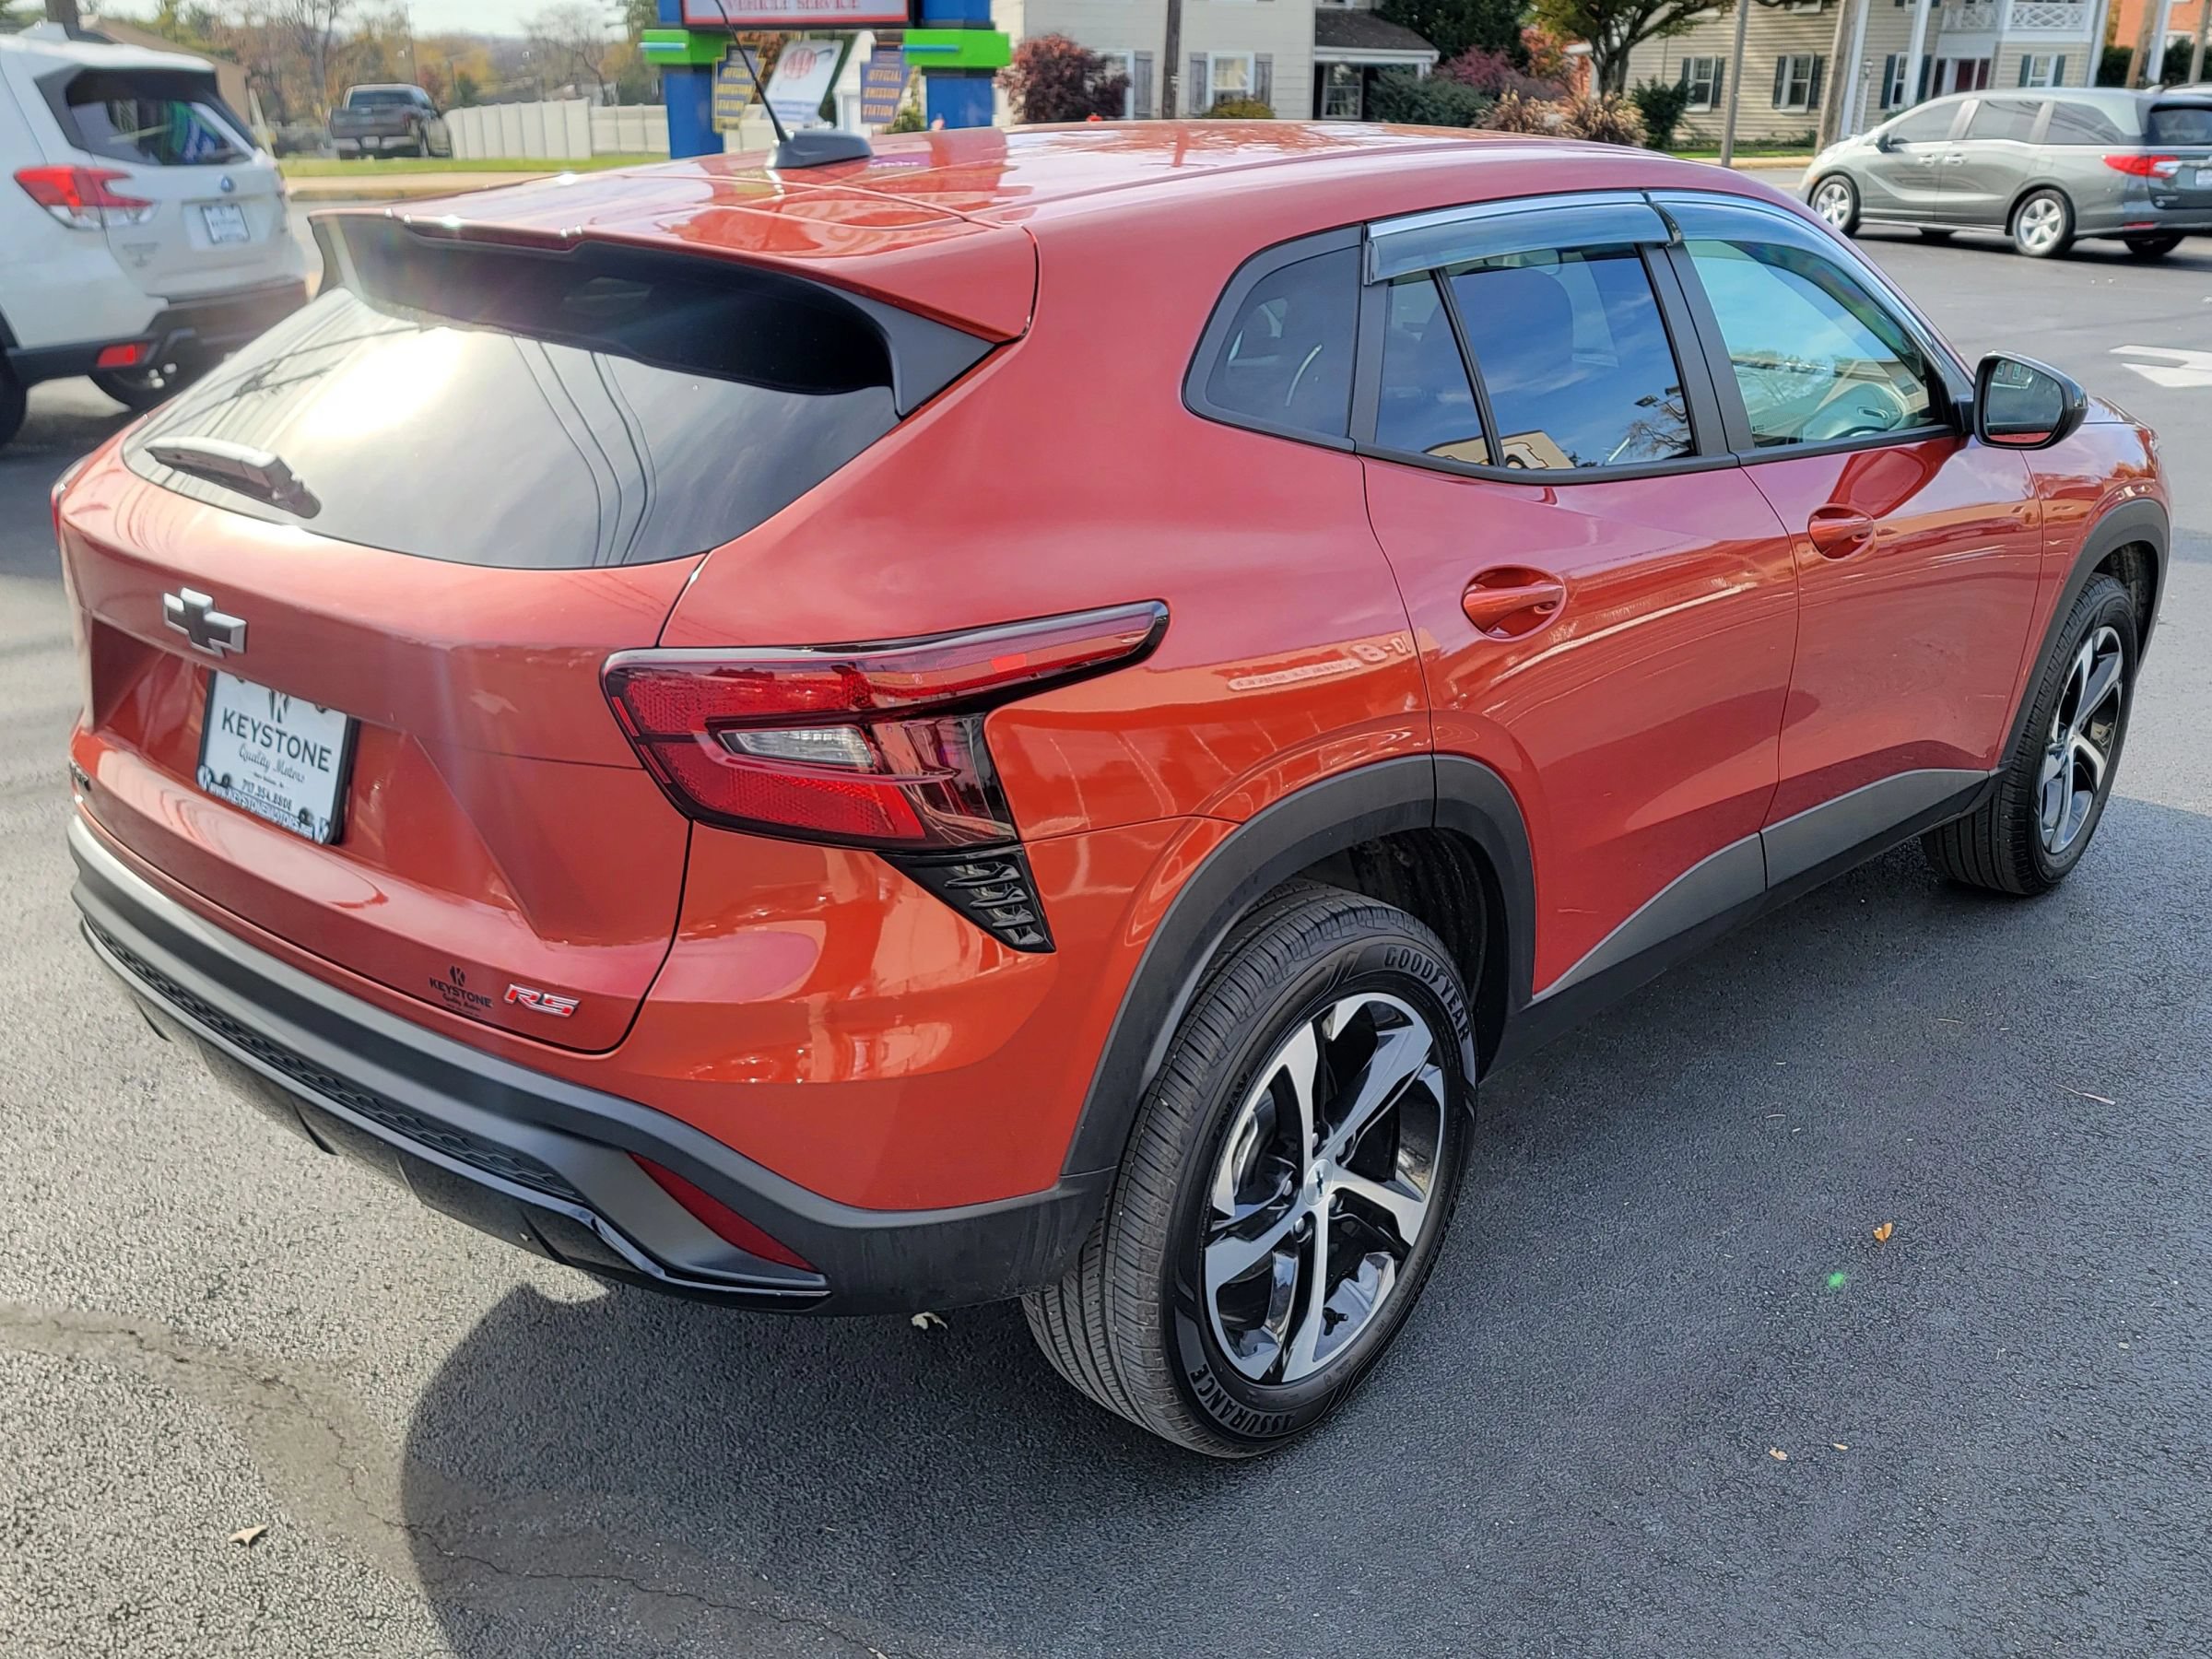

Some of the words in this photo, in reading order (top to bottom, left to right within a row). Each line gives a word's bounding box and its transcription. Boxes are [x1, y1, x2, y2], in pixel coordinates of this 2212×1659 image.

[796, 0, 861, 9] SERVICE
[221, 707, 333, 773] KEYSTONE
[239, 743, 272, 773] Quality
[273, 759, 305, 783] Motors
[429, 977, 494, 1008] KEYSTONE
[504, 983, 582, 1018] RS
[1384, 947, 1470, 1044] GOODYEAR
[1190, 1364, 1298, 1433] ASSURANCE
